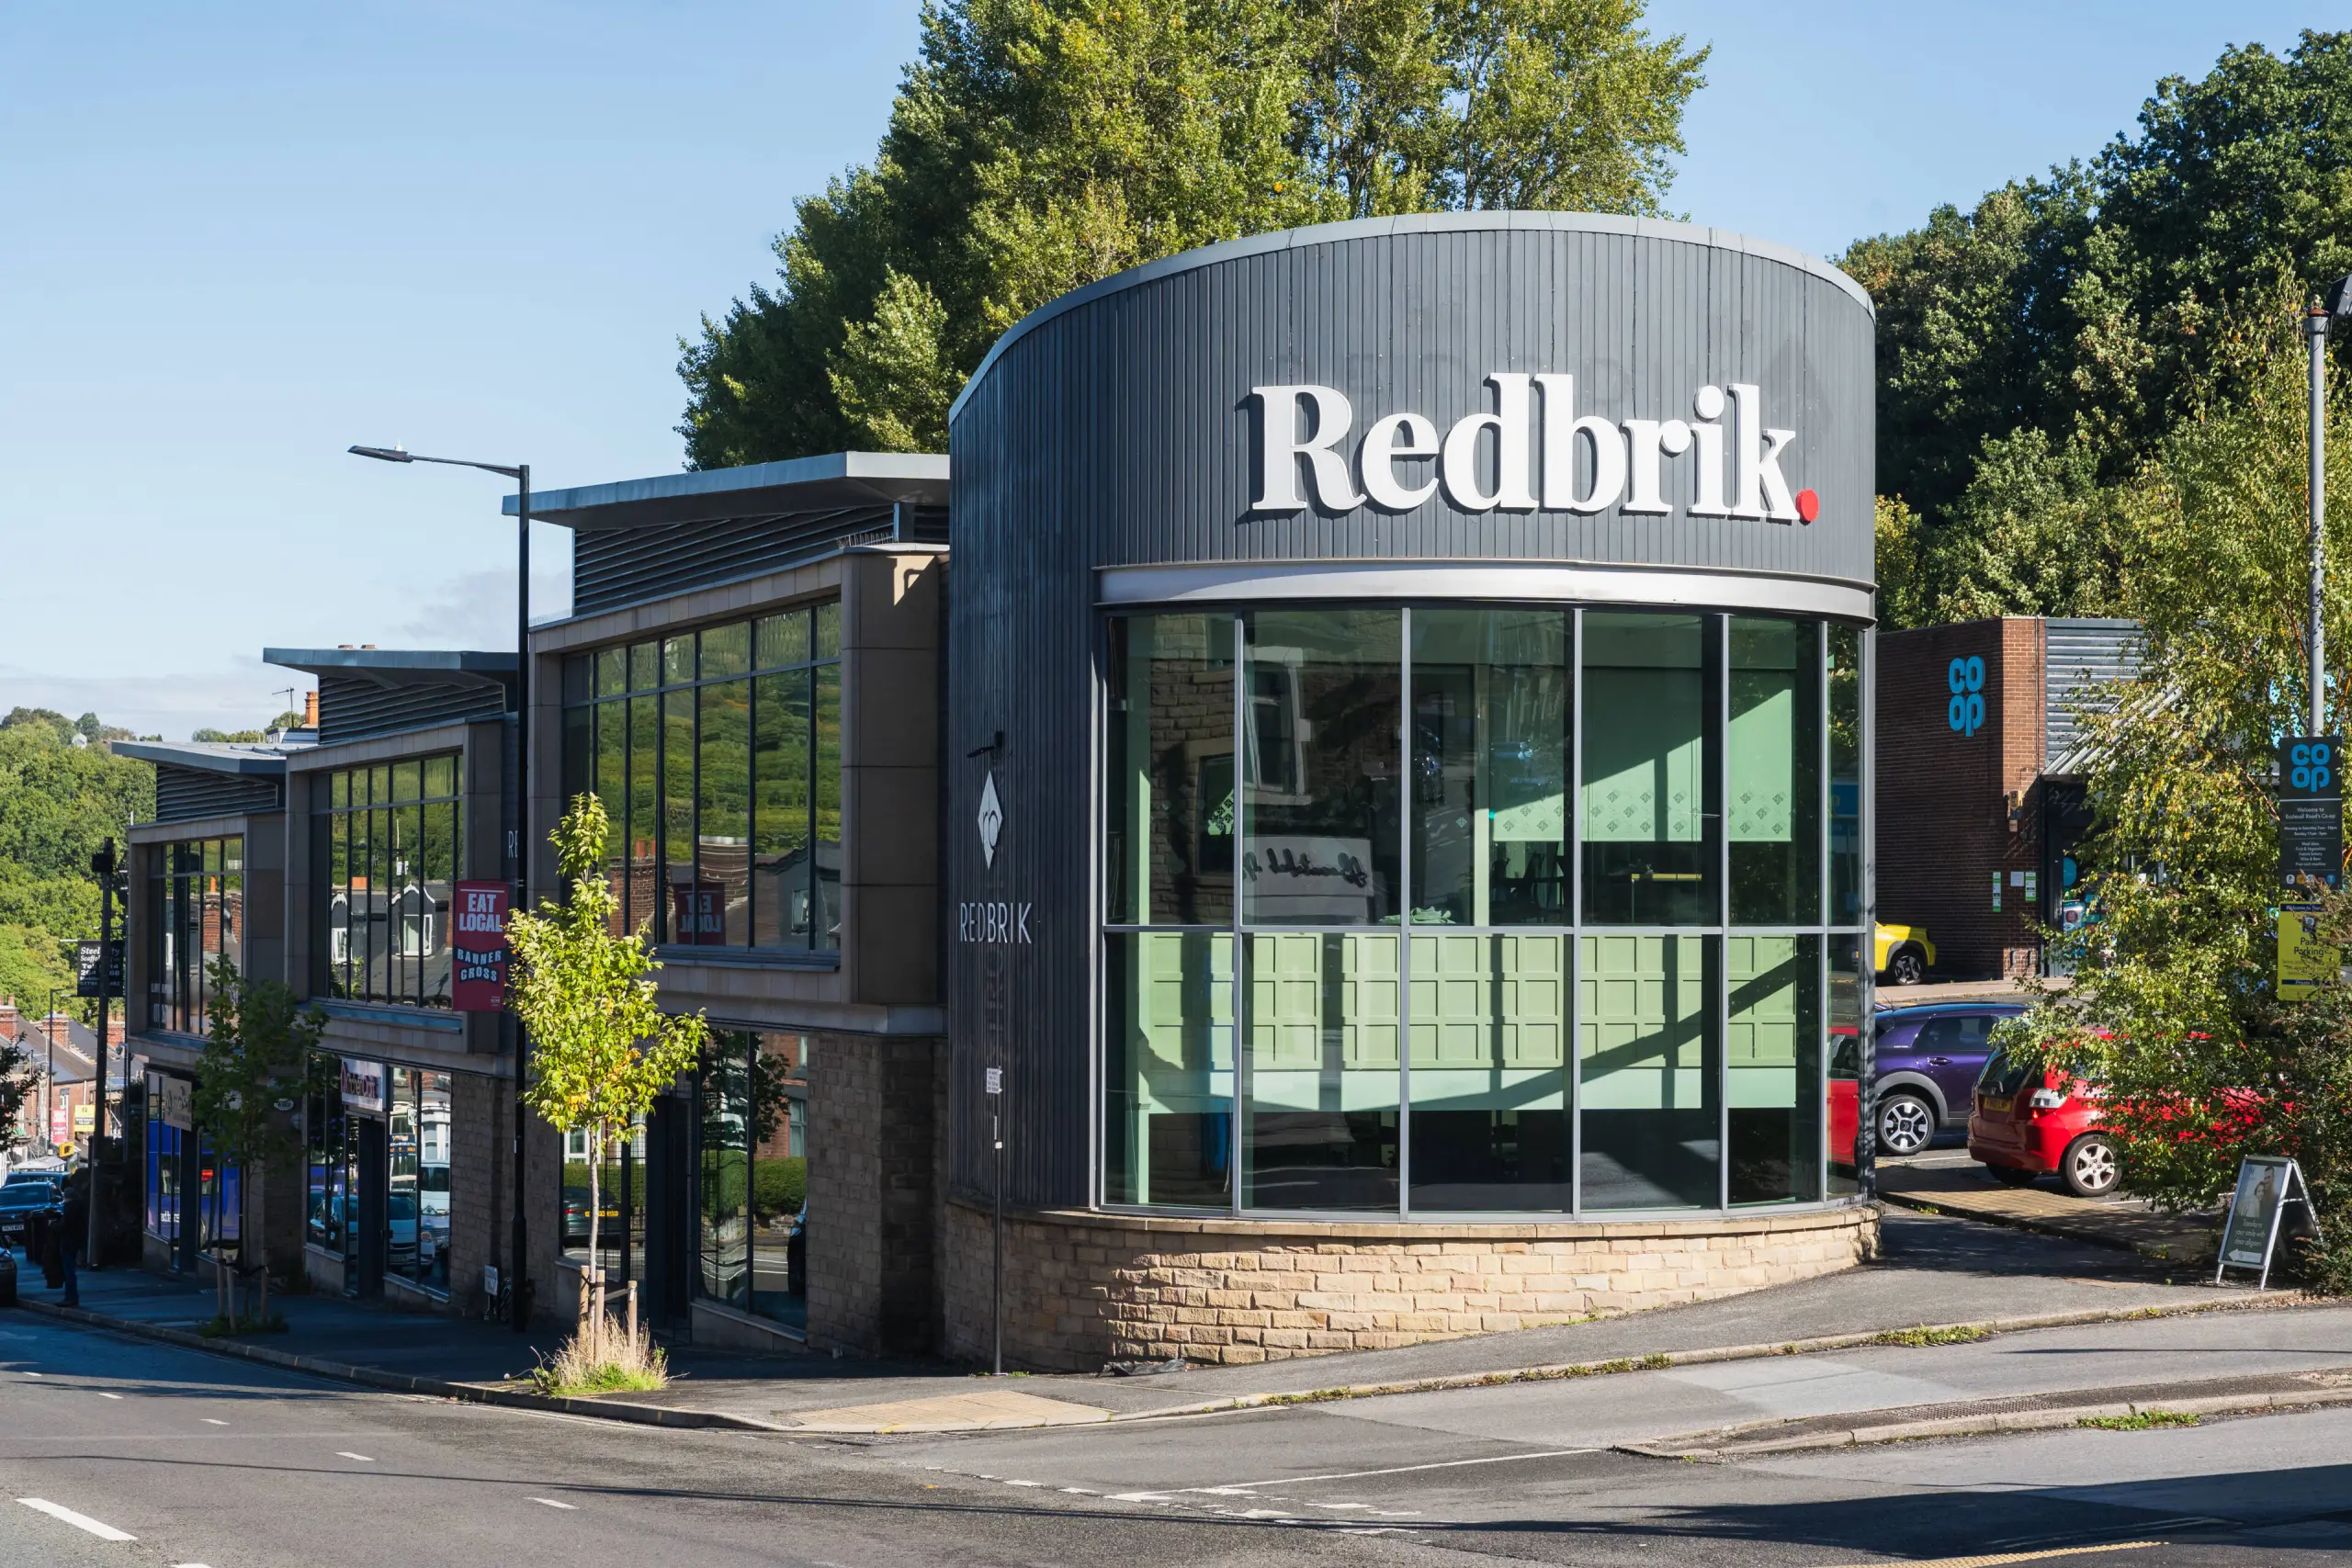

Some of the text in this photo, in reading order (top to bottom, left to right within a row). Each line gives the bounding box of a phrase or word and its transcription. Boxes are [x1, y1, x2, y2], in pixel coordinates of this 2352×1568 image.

[1252, 372, 1820, 523] Redbrik.
[468, 893, 497, 912] EAT
[459, 913, 503, 932] LOCAL
[960, 902, 1032, 944] REDBRIK
[457, 948, 502, 965] BANNER
[2293, 946, 2324, 957] Parking
[460, 966, 497, 982] CROSS
